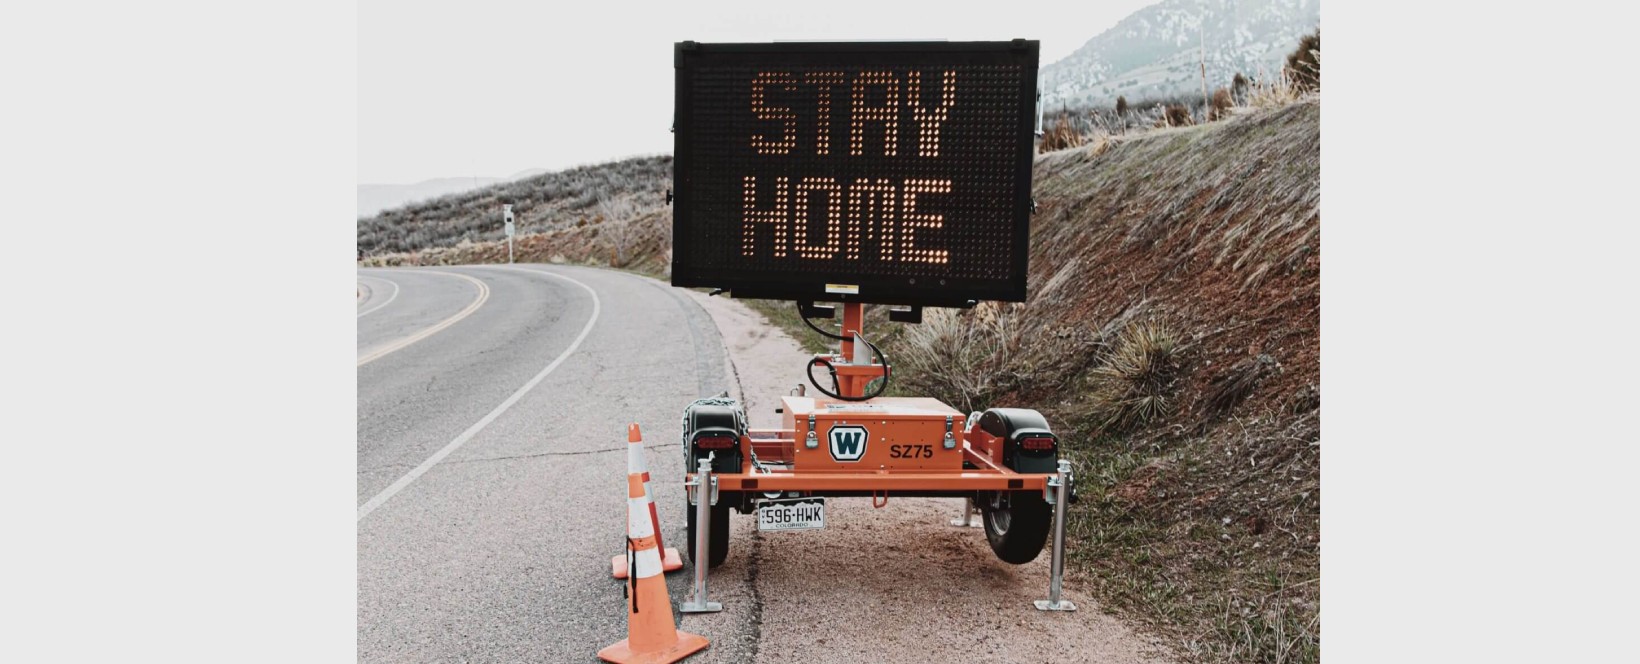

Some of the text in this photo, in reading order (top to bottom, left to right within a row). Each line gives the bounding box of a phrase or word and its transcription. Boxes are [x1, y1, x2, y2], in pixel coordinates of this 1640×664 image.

[751, 71, 956, 156] STAY
[742, 176, 951, 264] HOME
[834, 432, 862, 455] W
[889, 444, 933, 459] SZ75
